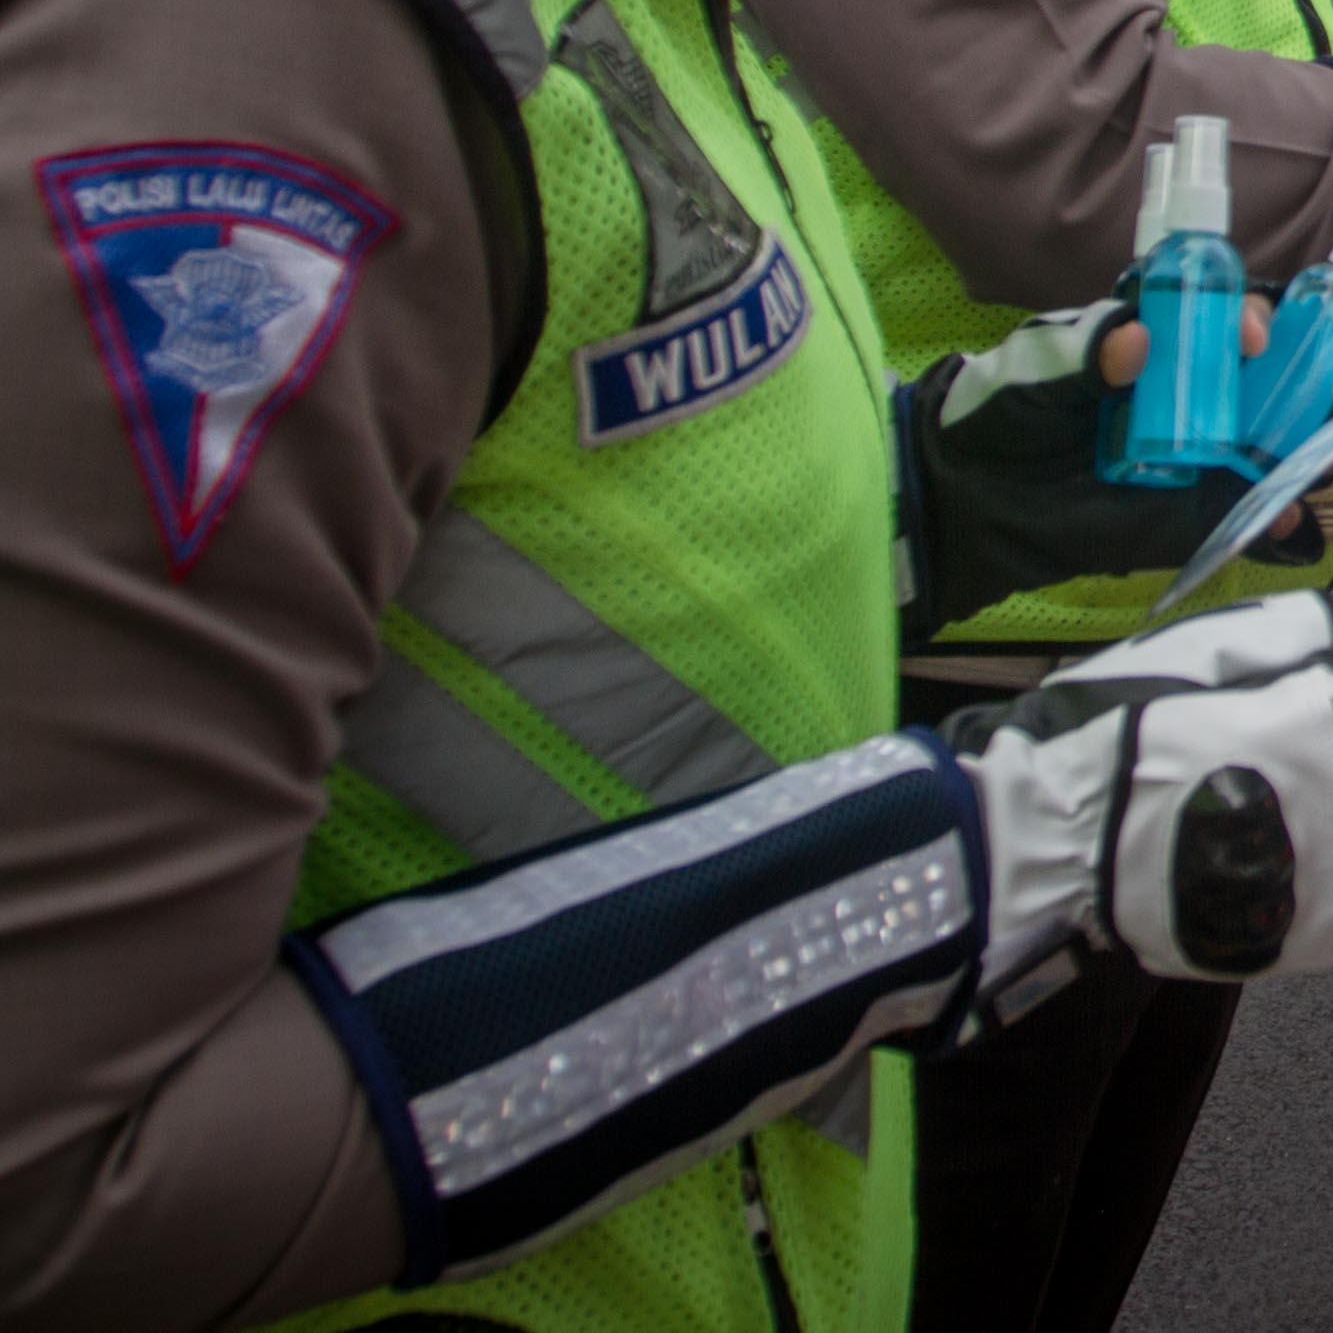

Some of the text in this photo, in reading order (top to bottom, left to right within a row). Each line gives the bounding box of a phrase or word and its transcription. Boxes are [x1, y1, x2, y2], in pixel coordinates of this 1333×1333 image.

[73, 171, 357, 253] POLISI LALU LINTAS
[624, 257, 802, 414] WULAN
